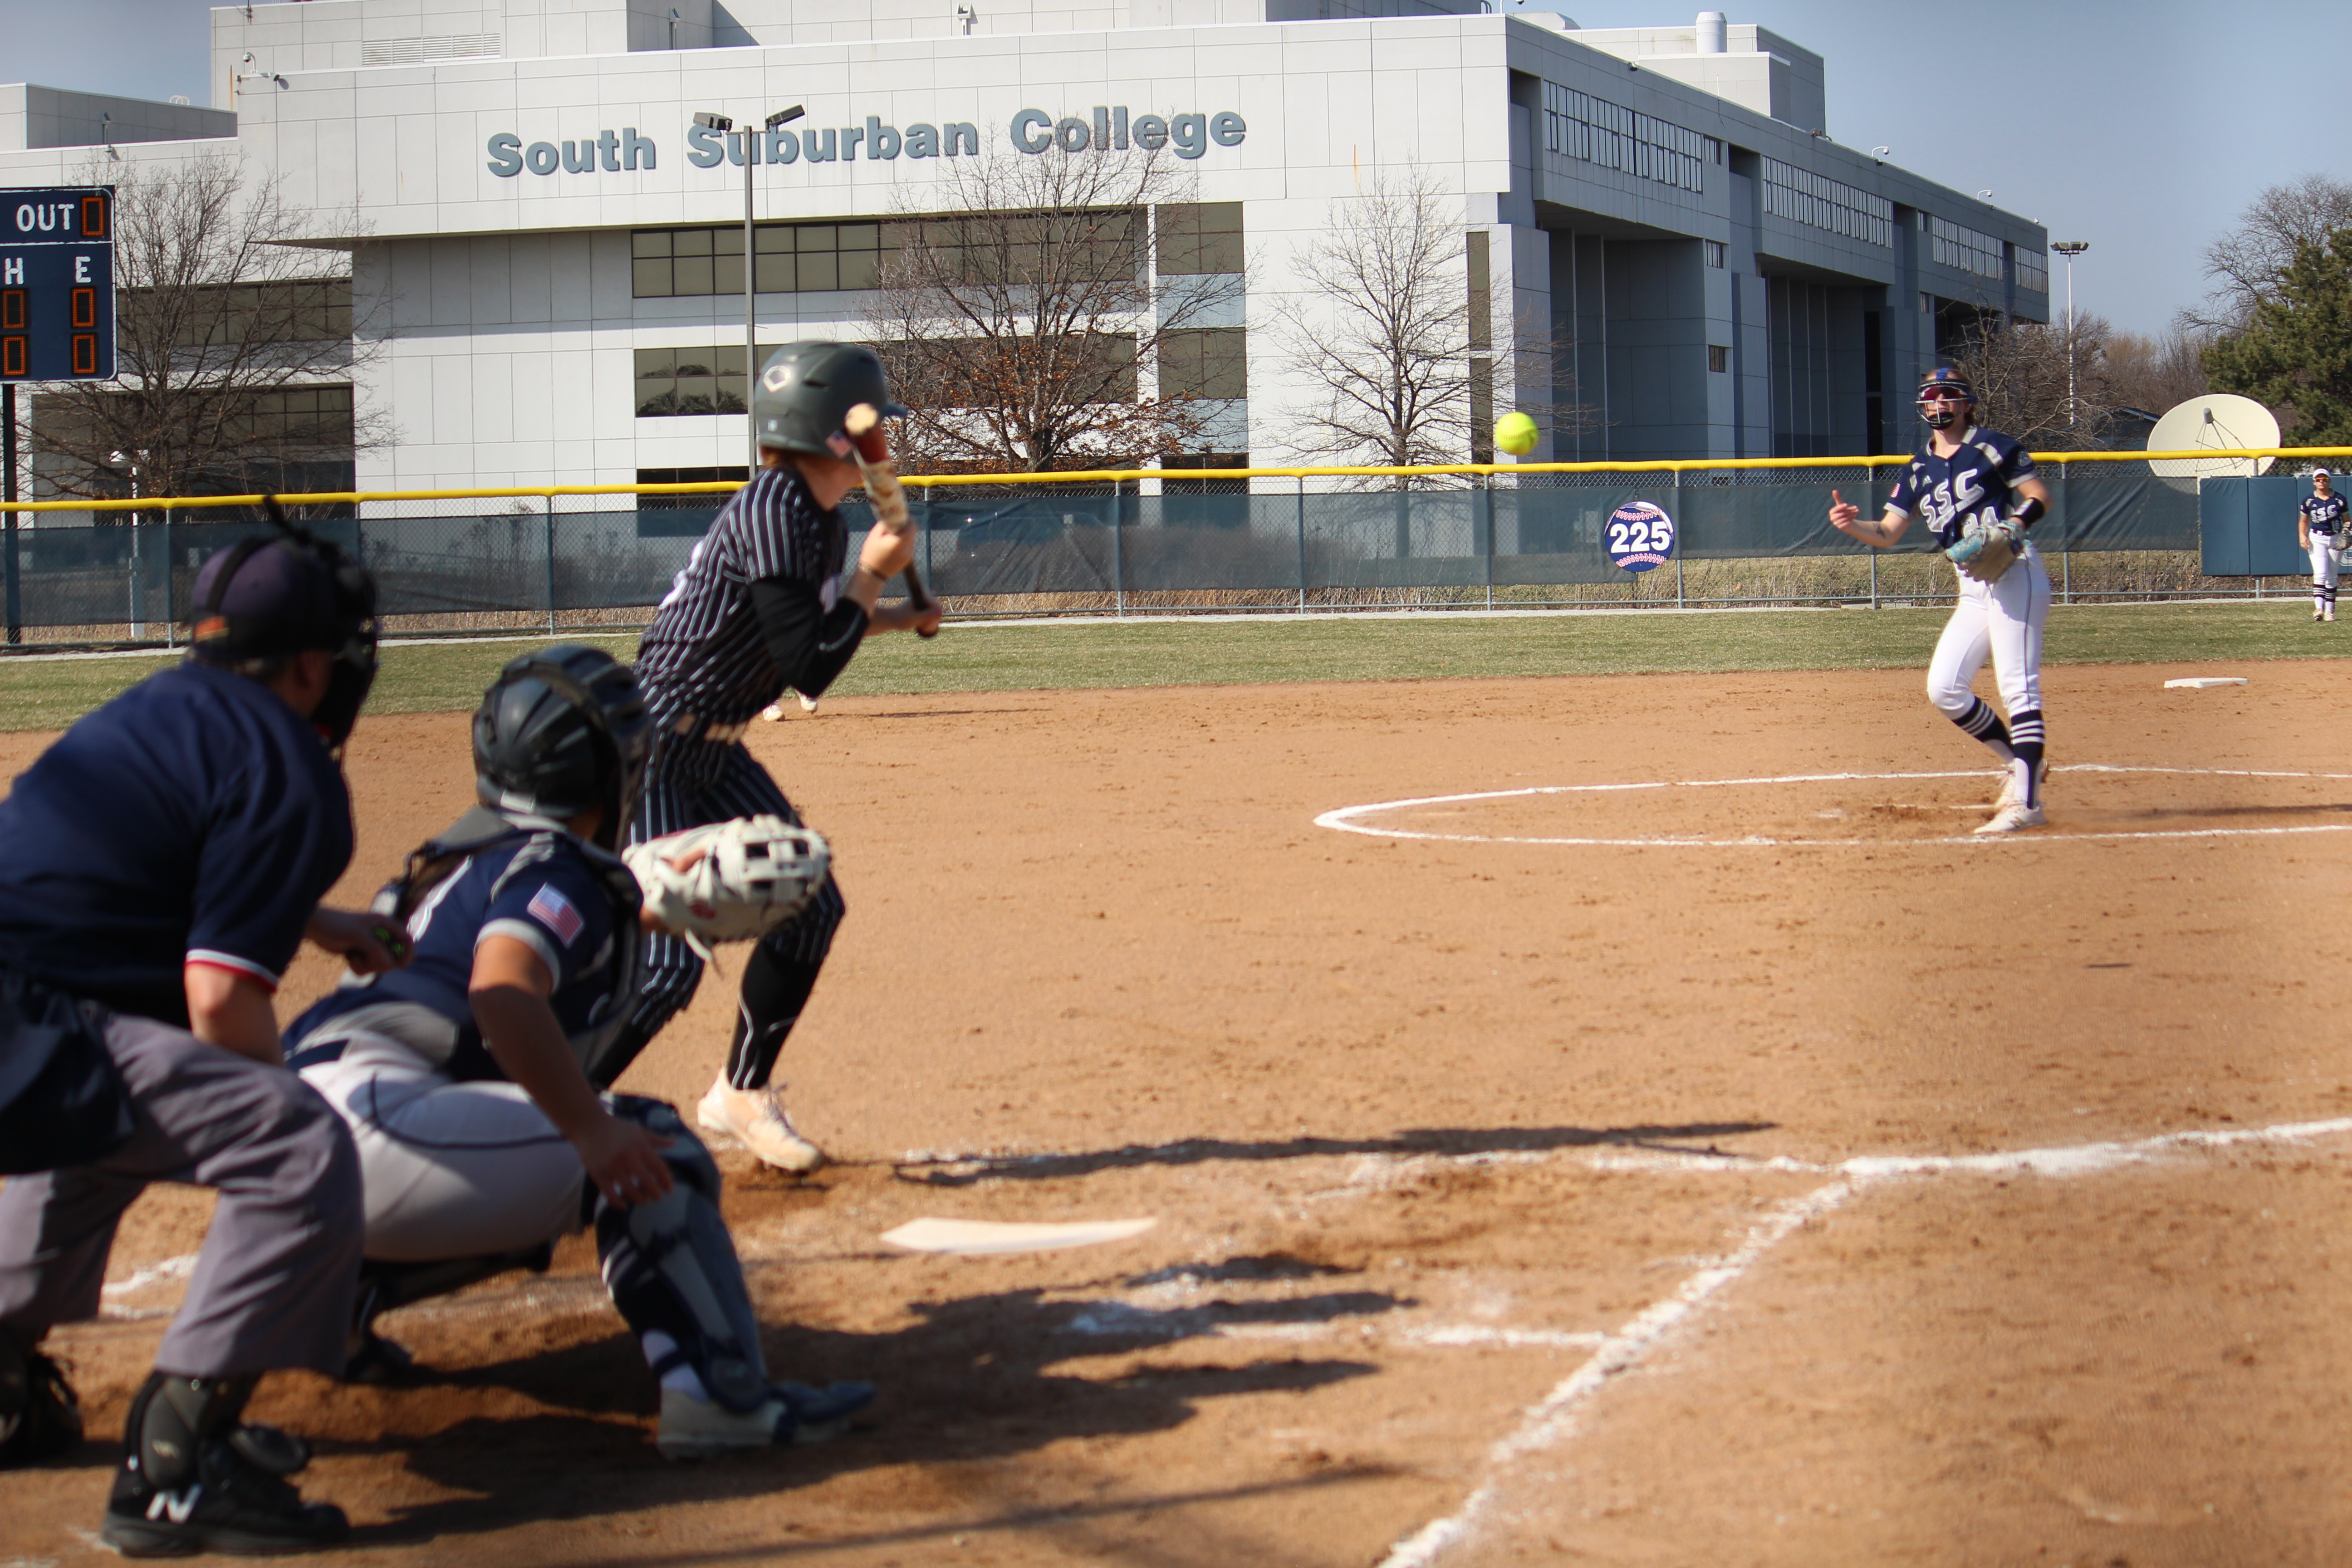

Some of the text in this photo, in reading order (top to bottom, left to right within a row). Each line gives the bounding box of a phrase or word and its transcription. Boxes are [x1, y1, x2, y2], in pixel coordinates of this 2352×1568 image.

[487, 106, 1246, 177] South Suburban College
[16, 204, 75, 232] OUT
[82, 197, 104, 236] 0
[4, 257, 24, 284] H
[75, 256, 92, 283] E
[2, 289, 25, 328] 0
[72, 288, 94, 327] 0
[3, 336, 25, 375] 0
[73, 334, 95, 373] 0
[1919, 468, 1984, 533] SSC
[2310, 504, 2337, 524] SSC
[1609, 521, 1671, 554] 225
